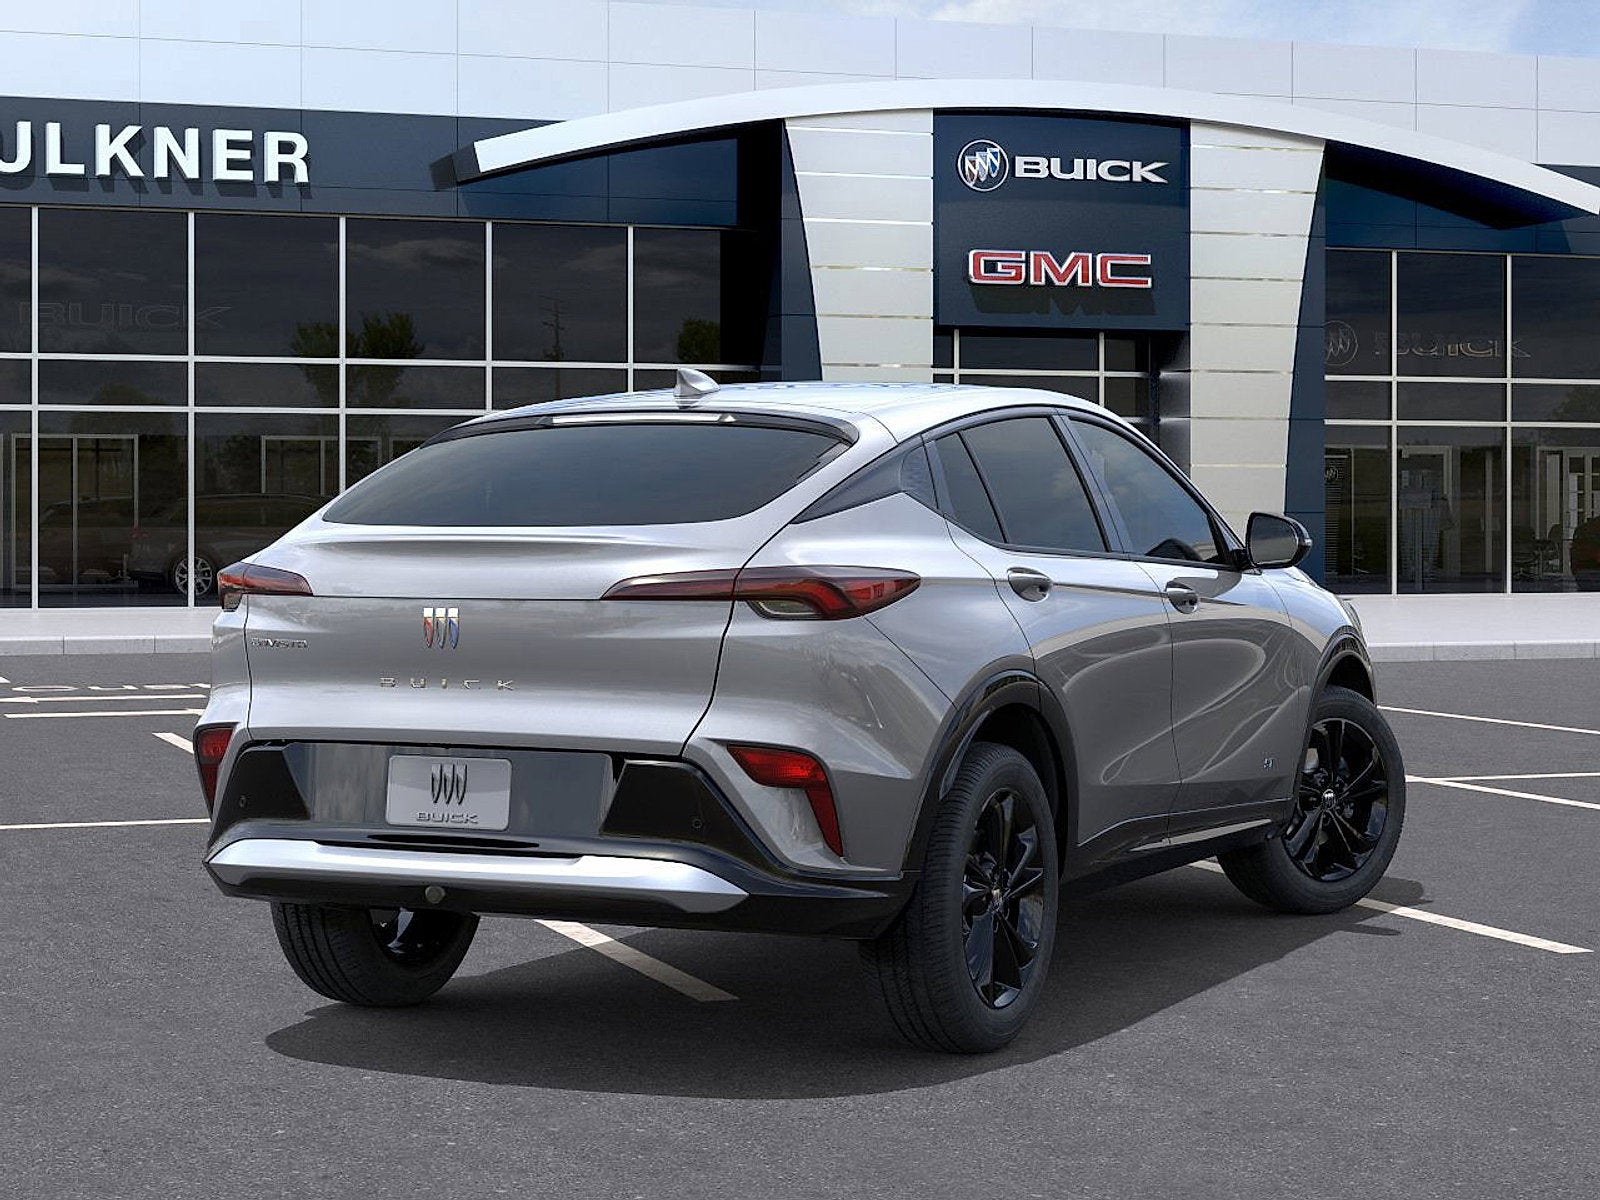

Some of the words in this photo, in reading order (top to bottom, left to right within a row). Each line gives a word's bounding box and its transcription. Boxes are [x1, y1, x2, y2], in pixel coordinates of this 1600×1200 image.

[1014, 155, 1171, 184] BUICK
[968, 249, 1153, 289] GMC
[379, 676, 515, 691] BUICK
[416, 811, 479, 825] BUICK
